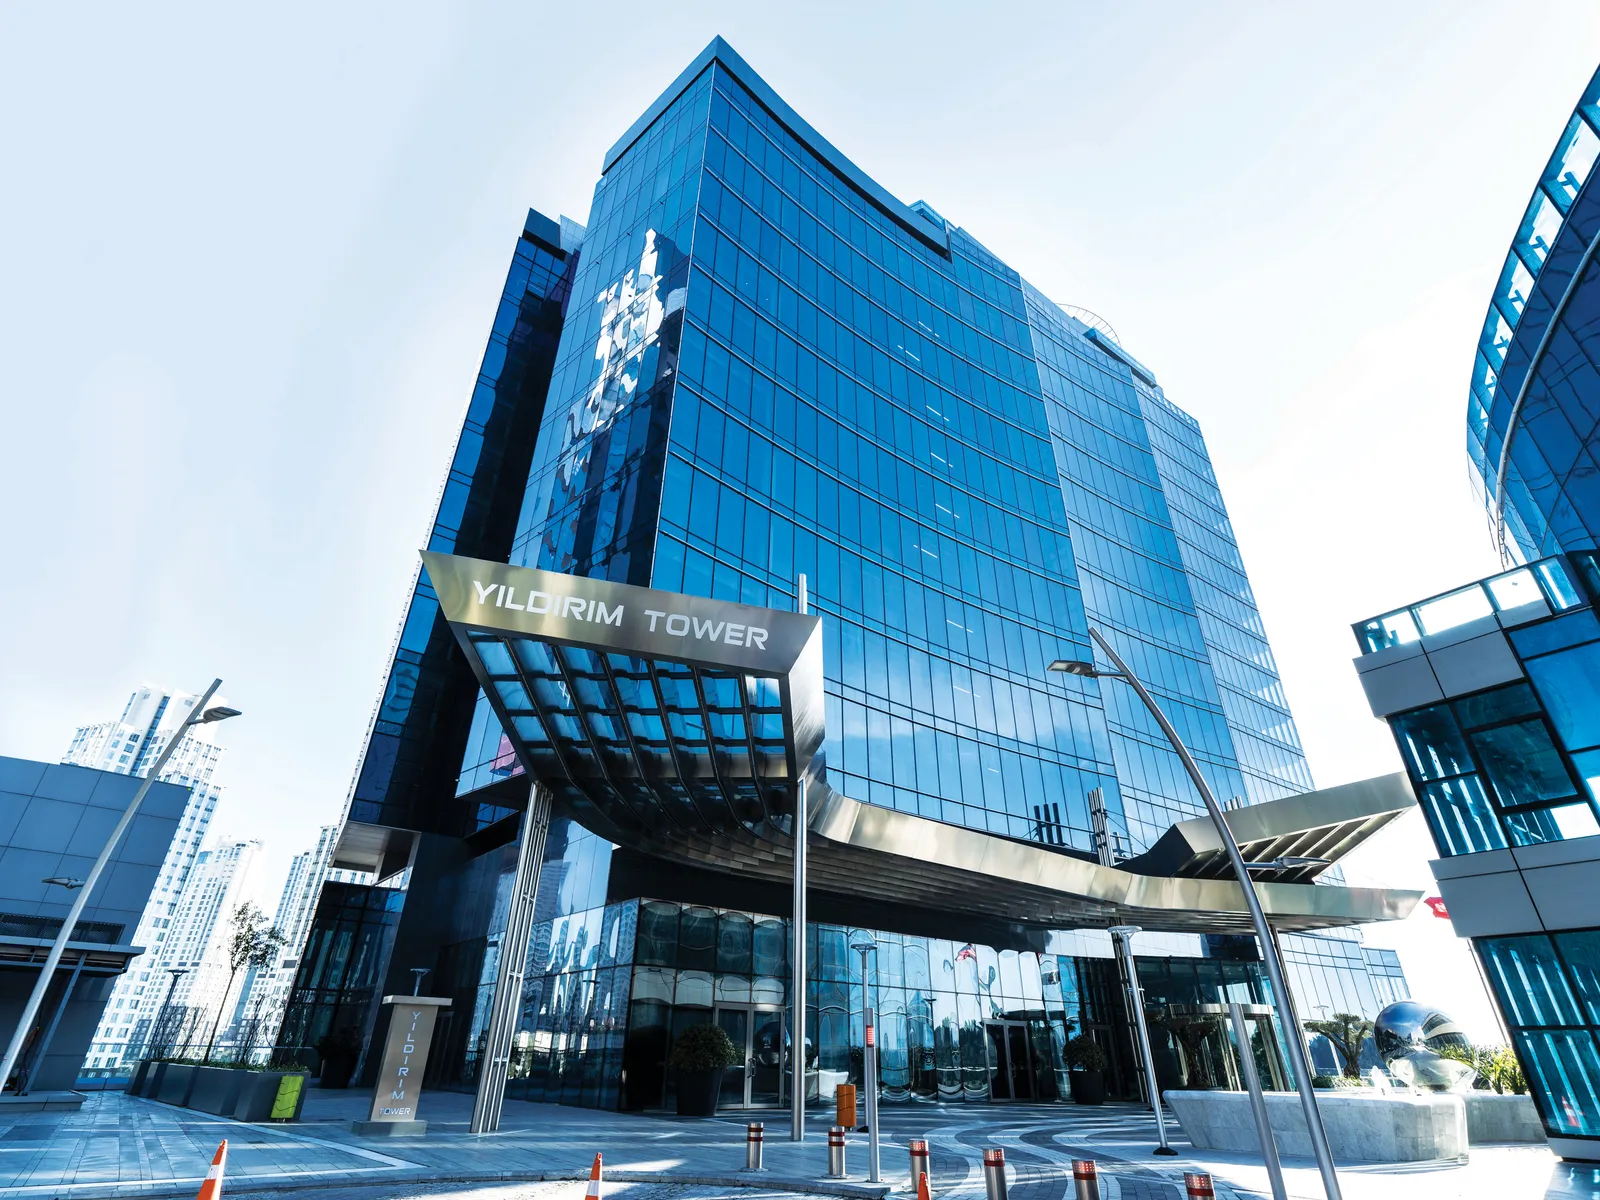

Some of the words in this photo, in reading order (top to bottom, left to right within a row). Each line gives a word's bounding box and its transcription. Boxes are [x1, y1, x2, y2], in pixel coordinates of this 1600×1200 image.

[472, 580, 624, 627] YILDIRIM
[644, 609, 769, 651] TOWER
[391, 1011, 422, 1100] YILDIRIM
[379, 1107, 411, 1115] TOWER
